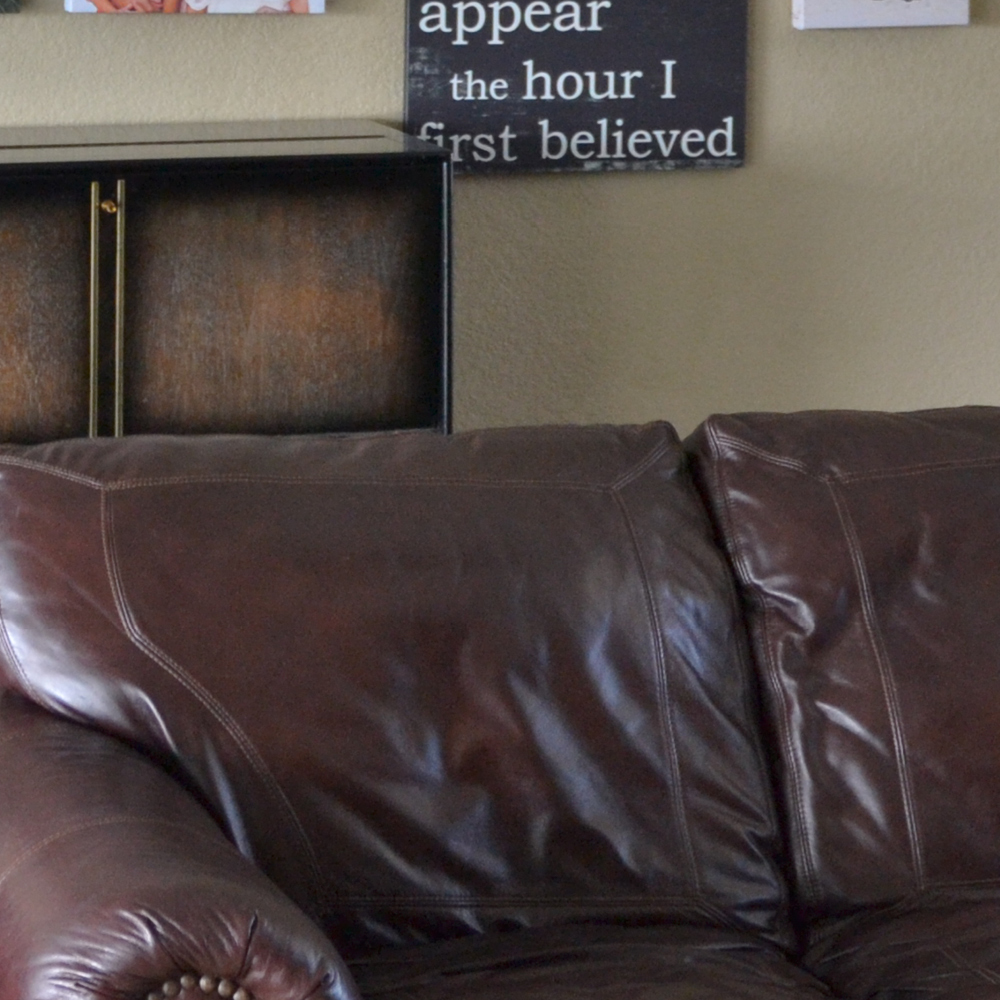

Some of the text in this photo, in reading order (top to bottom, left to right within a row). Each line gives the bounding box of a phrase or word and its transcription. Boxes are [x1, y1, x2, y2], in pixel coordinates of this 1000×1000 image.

[418, 0, 612, 46] appear
[449, 59, 677, 101] the hour I
[537, 115, 737, 160] believed
